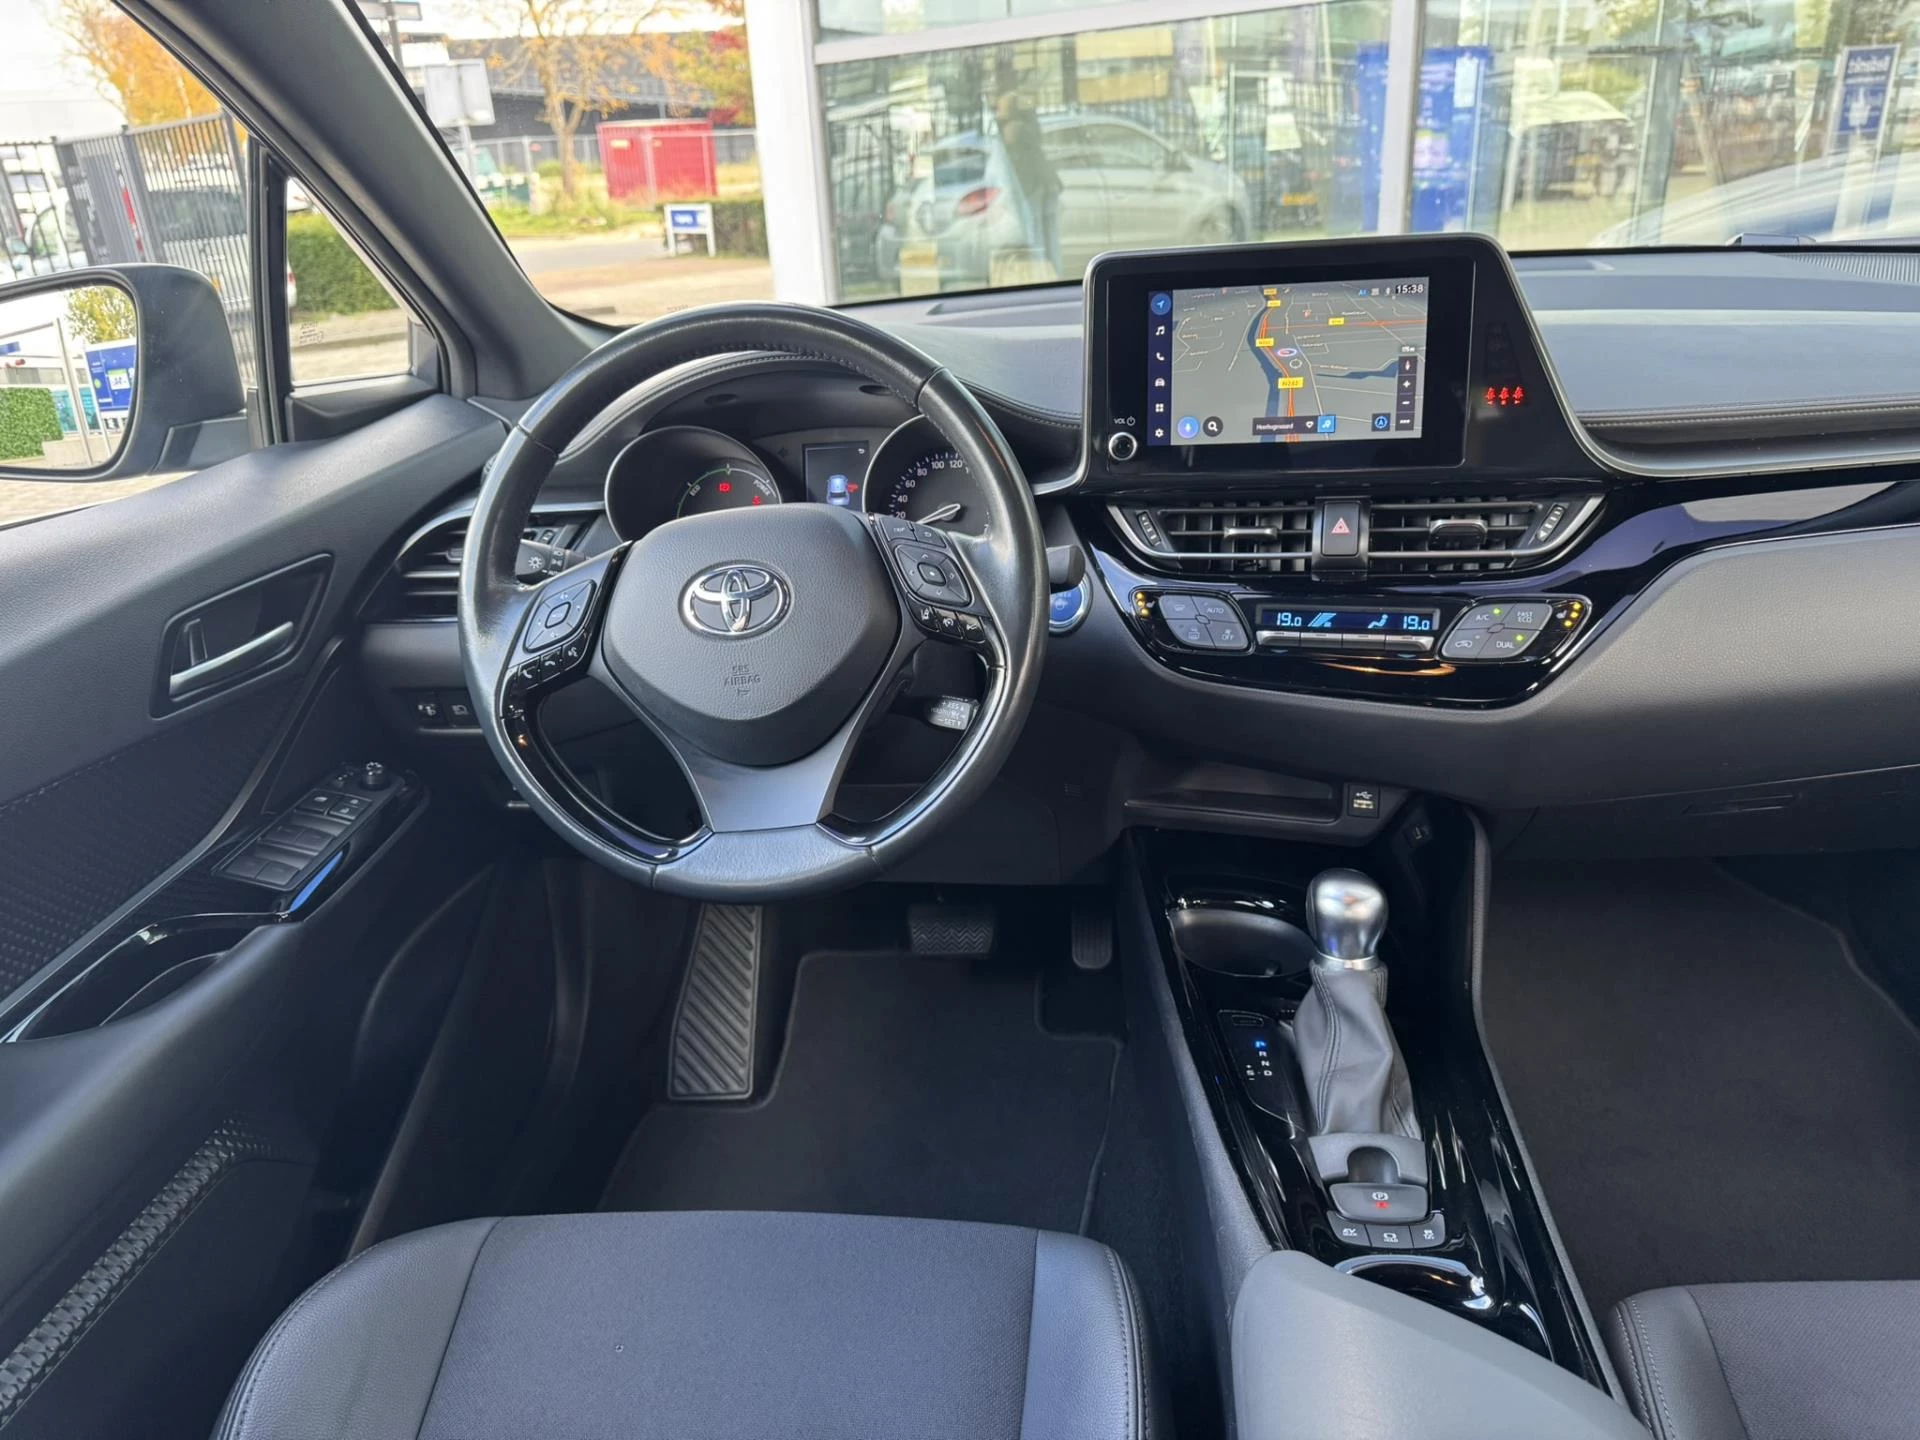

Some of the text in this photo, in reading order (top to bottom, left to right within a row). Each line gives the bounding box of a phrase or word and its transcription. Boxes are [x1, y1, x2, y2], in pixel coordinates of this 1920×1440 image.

[1396, 284, 1424, 294] 15:38
[931, 461, 944, 469] 100
[949, 460, 963, 468] 120
[916, 468, 927, 476] 80
[753, 479, 771, 496] POWER
[905, 480, 916, 488] 60
[689, 484, 701, 496] ECO
[897, 495, 908, 503] 40
[1276, 612, 1302, 627] 19.0
[1403, 615, 1430, 631] 19.0
[724, 674, 761, 686] AIRBAG
